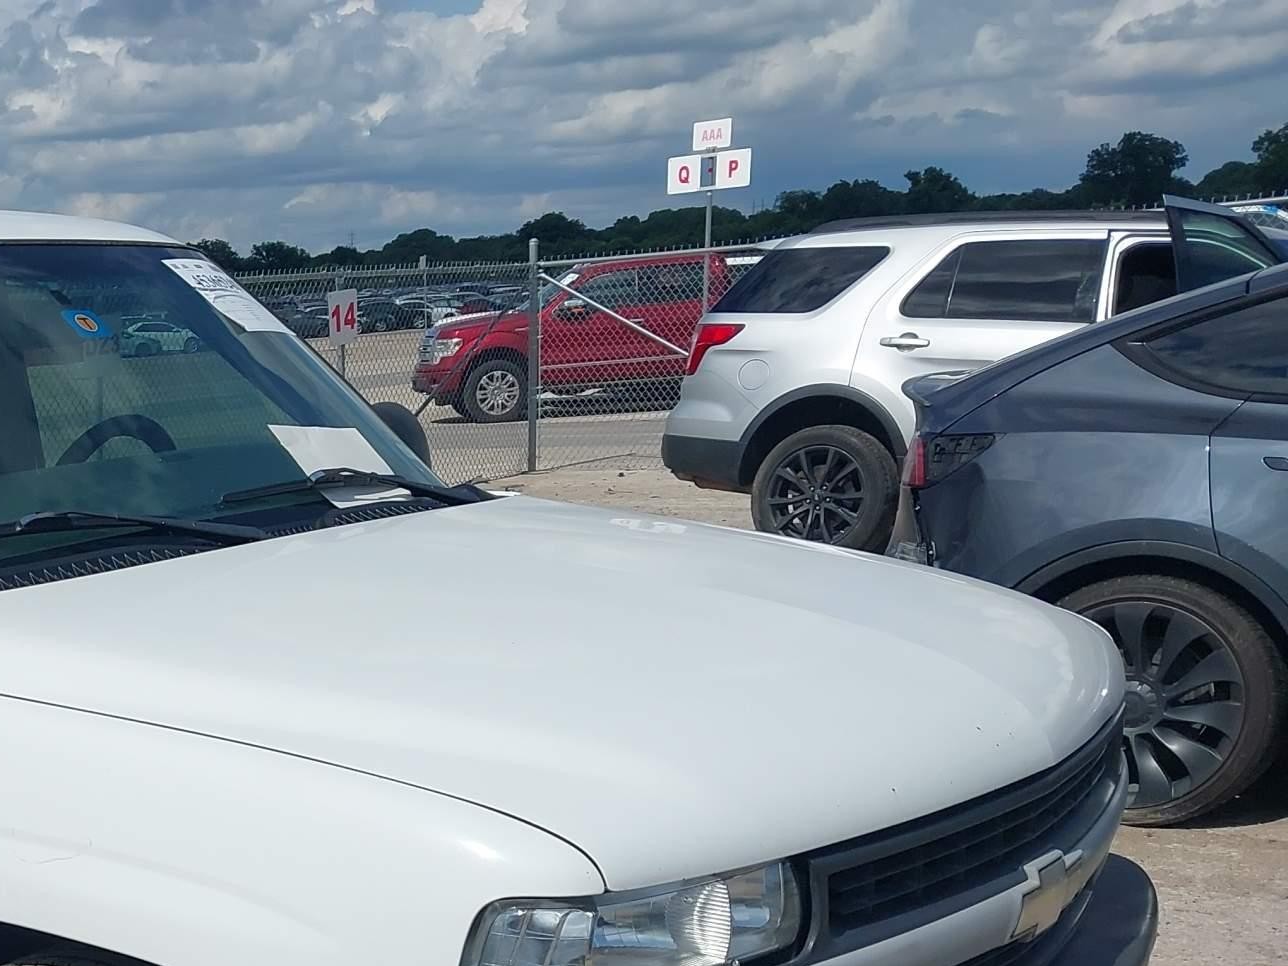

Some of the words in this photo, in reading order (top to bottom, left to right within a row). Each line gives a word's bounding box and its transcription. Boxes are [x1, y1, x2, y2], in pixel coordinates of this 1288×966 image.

[701, 127, 723, 142] AAA
[678, 165, 690, 184] Q
[728, 160, 739, 178] P
[331, 301, 356, 332] 14
